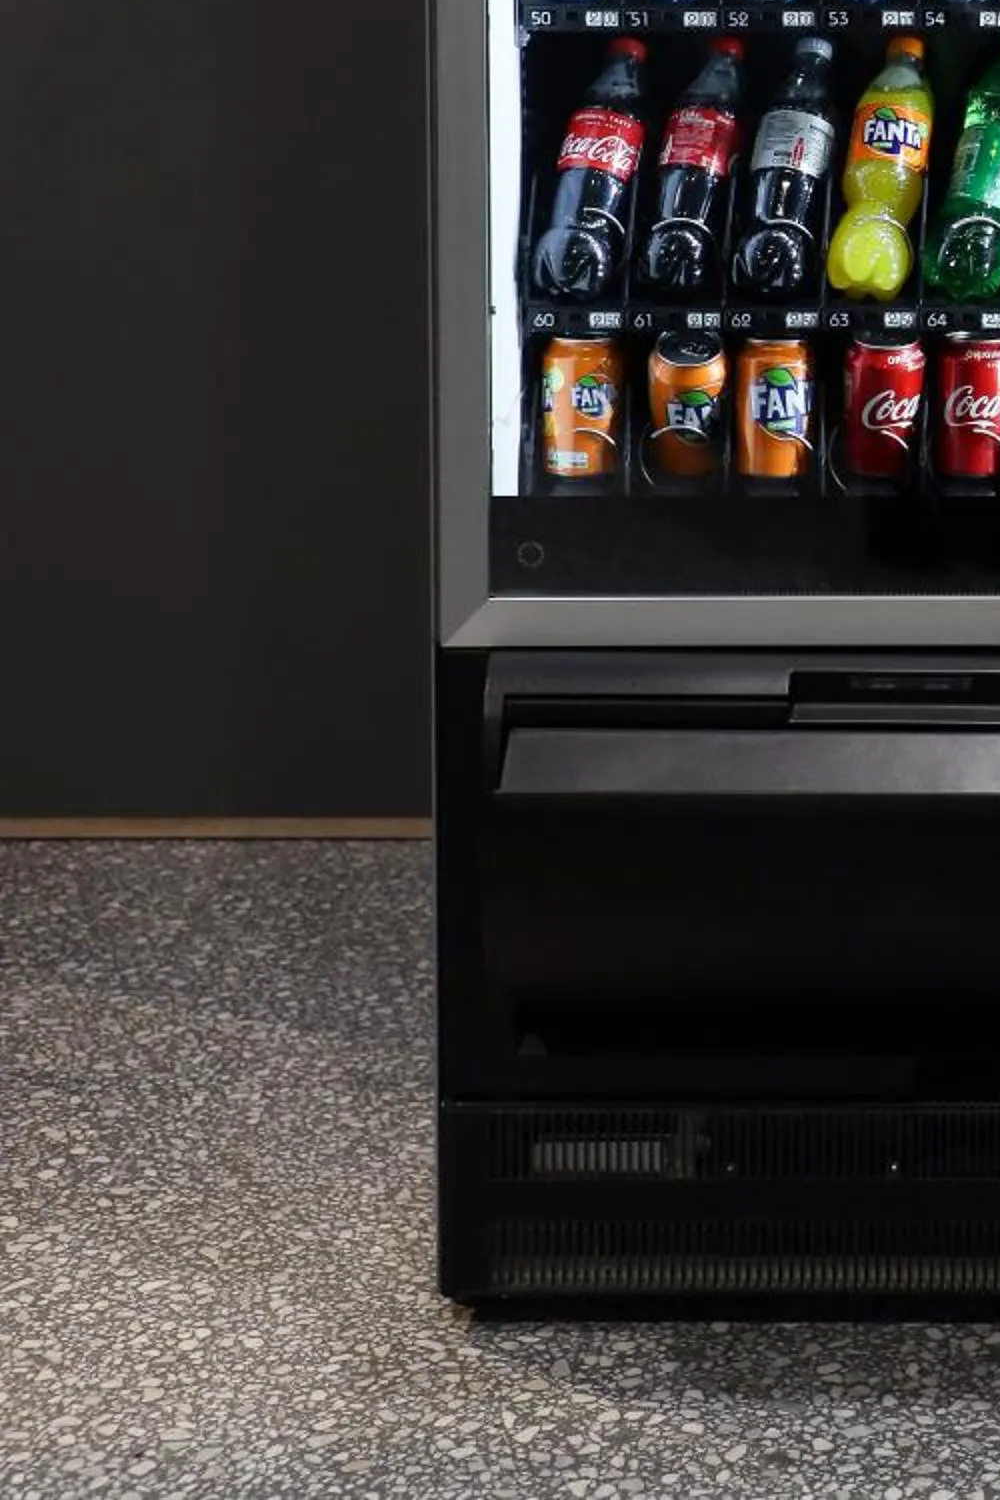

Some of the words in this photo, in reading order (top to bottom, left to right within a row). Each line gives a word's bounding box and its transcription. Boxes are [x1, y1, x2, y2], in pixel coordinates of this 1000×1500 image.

[532, 11, 550, 25] 50
[631, 12, 648, 26] 51
[729, 12, 748, 26] 52
[829, 12, 848, 26] 53
[926, 12, 944, 26] 54
[863, 116, 921, 149] FANTA
[534, 313, 554, 327] 60
[634, 314, 651, 327] 61
[732, 314, 750, 326] 62
[830, 314, 848, 326] 63
[928, 314, 946, 326] 64
